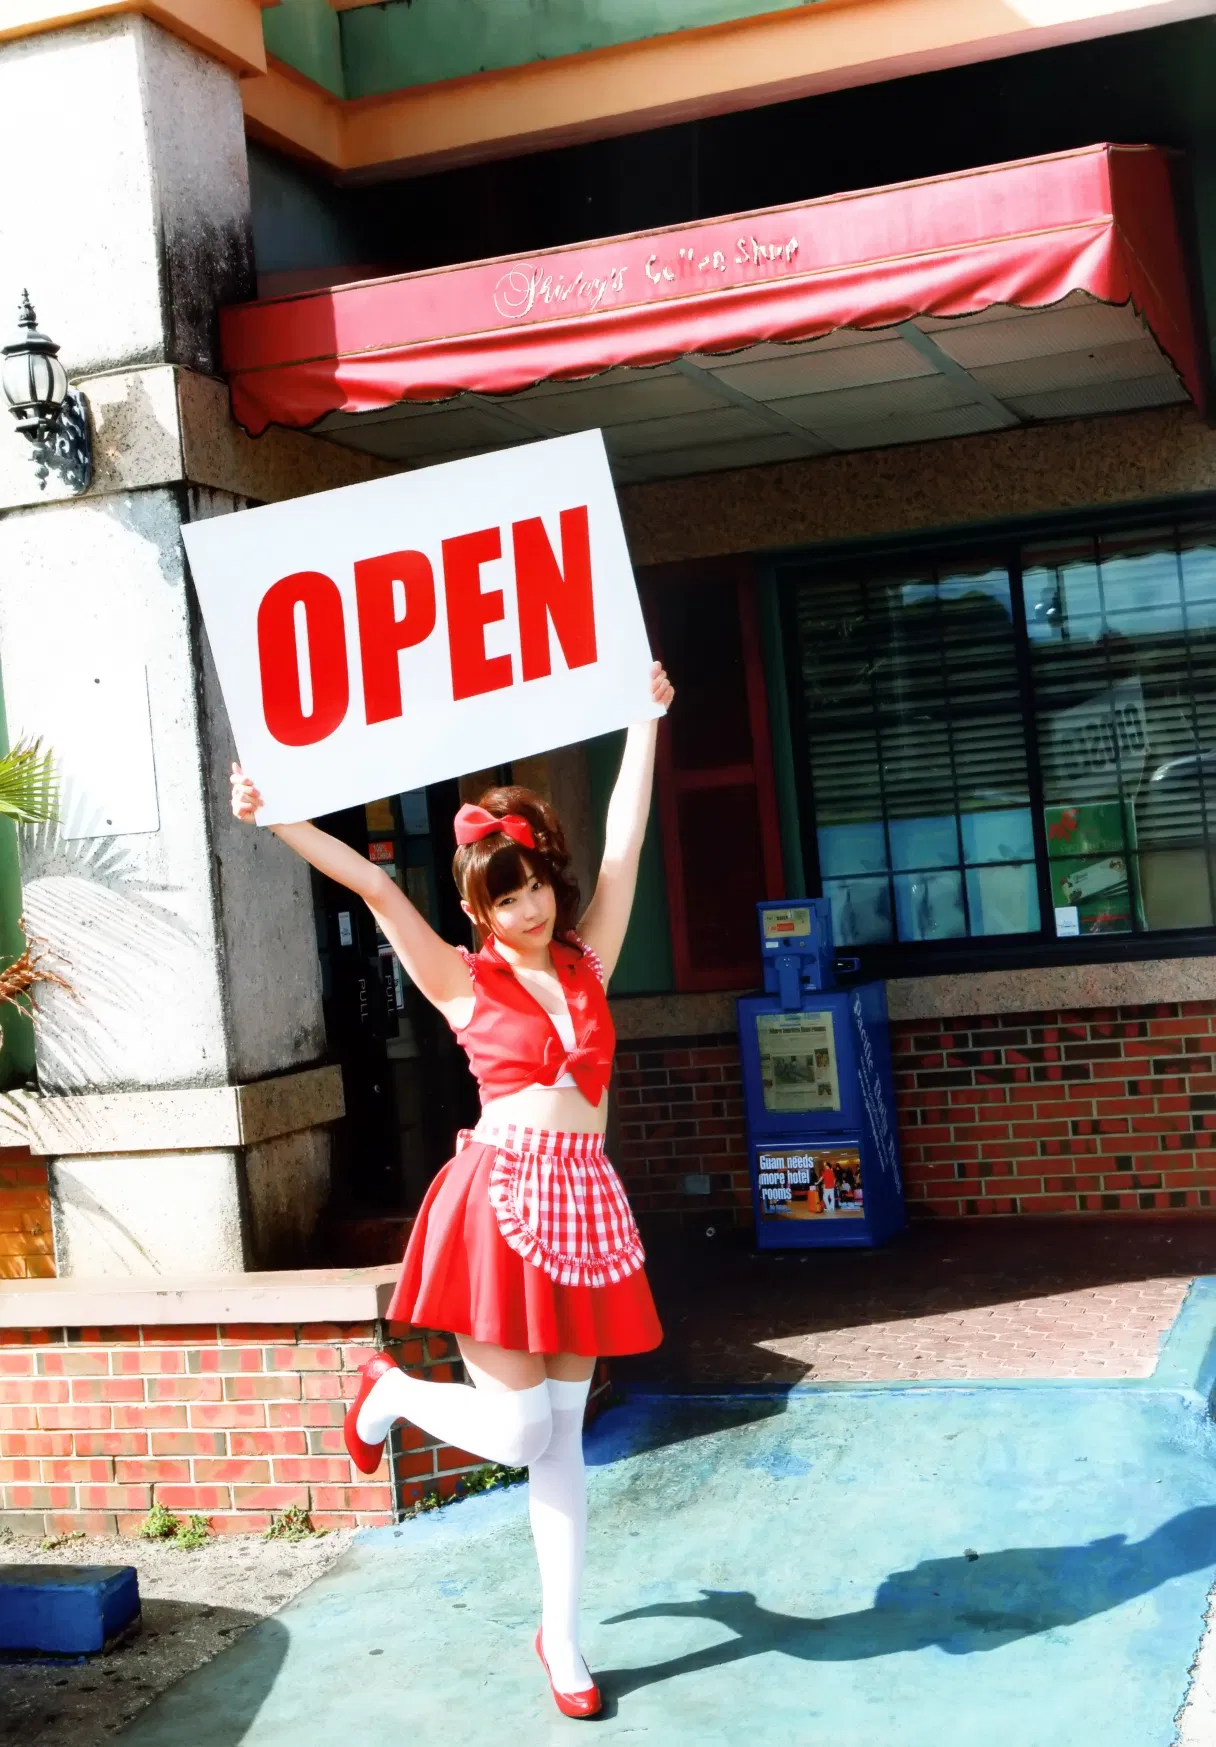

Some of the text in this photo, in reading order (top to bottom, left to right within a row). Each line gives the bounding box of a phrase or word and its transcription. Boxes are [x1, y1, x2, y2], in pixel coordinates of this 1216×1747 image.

[645, 248, 727, 284] Coee
[257, 505, 598, 747] OPEN
[358, 978, 369, 1023] PULL
[385, 975, 395, 1017] PULL
[759, 1169, 810, 1185] more hotel
[760, 1154, 814, 1170] Guam needs
[762, 1187, 793, 1200] rooms
